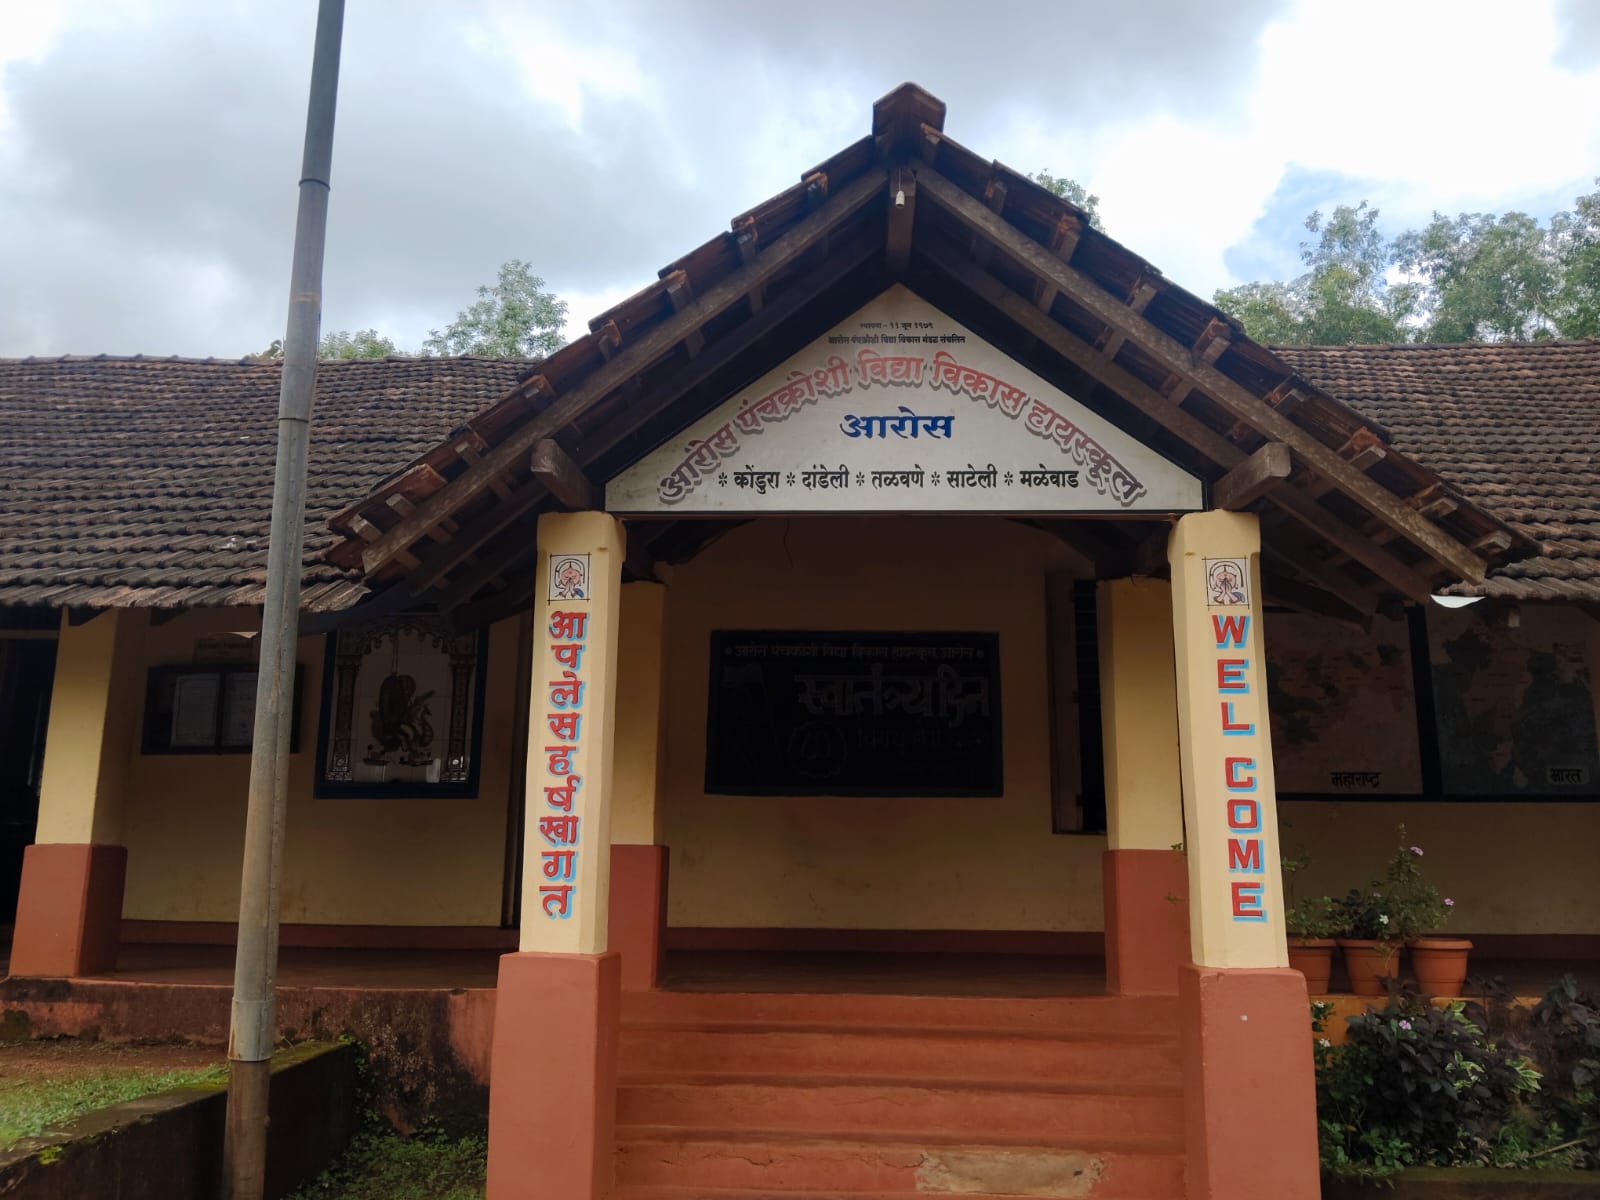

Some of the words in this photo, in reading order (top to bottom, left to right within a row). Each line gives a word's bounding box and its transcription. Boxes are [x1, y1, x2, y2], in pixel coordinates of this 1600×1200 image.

[658, 423, 739, 501] आरोस
[735, 355, 850, 432] पंचक्रोशी
[856, 348, 925, 387] विद्या
[932, 351, 1027, 414] विकास
[1026, 398, 1145, 502] हायस्कूल
[840, 405, 956, 439] आरोस
[733, 464, 781, 494] कोंडुरा
[801, 463, 850, 490] दांडेली
[871, 463, 925, 489] तळवणे
[946, 463, 998, 489] साटेली
[1019, 463, 1080, 489] मळेवाड
[1329, 771, 1382, 788] महाराष्ट्र
